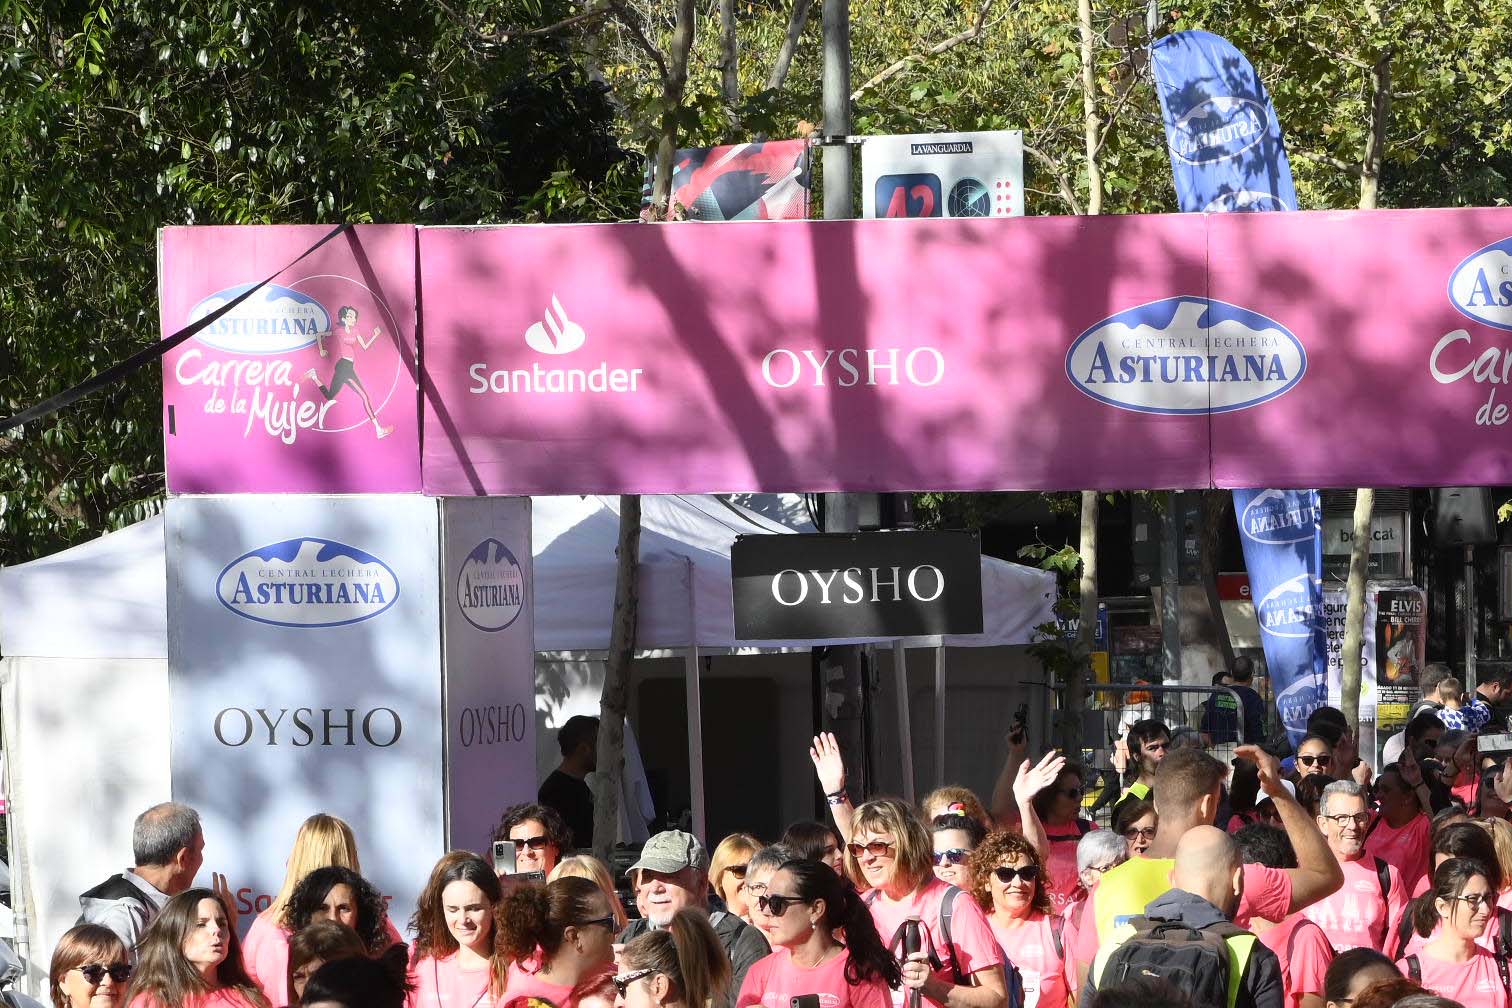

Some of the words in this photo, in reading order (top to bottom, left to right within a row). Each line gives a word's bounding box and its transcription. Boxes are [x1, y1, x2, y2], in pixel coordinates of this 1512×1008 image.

[1122, 337, 1199, 348] CENTRAL
[1204, 336, 1279, 348] LECHERA
[175, 349, 293, 387] Carrera
[469, 359, 643, 394] Santander
[762, 345, 946, 388] OYSHO
[1085, 340, 1288, 385] ASTURIANA
[204, 389, 226, 414] de
[230, 389, 247, 414] la
[244, 383, 338, 445] Mujer
[1475, 387, 1510, 427] de
[230, 571, 387, 606] ASTURIANA
[258, 568, 318, 578] CENTRAL
[322, 568, 380, 578] LECHERA
[770, 564, 946, 607] OYSHO
[462, 576, 521, 610] ASTURIANA
[1391, 600, 1422, 614] ELVIS
[213, 706, 403, 749] OYSHO
[459, 703, 527, 749] OYSHO
